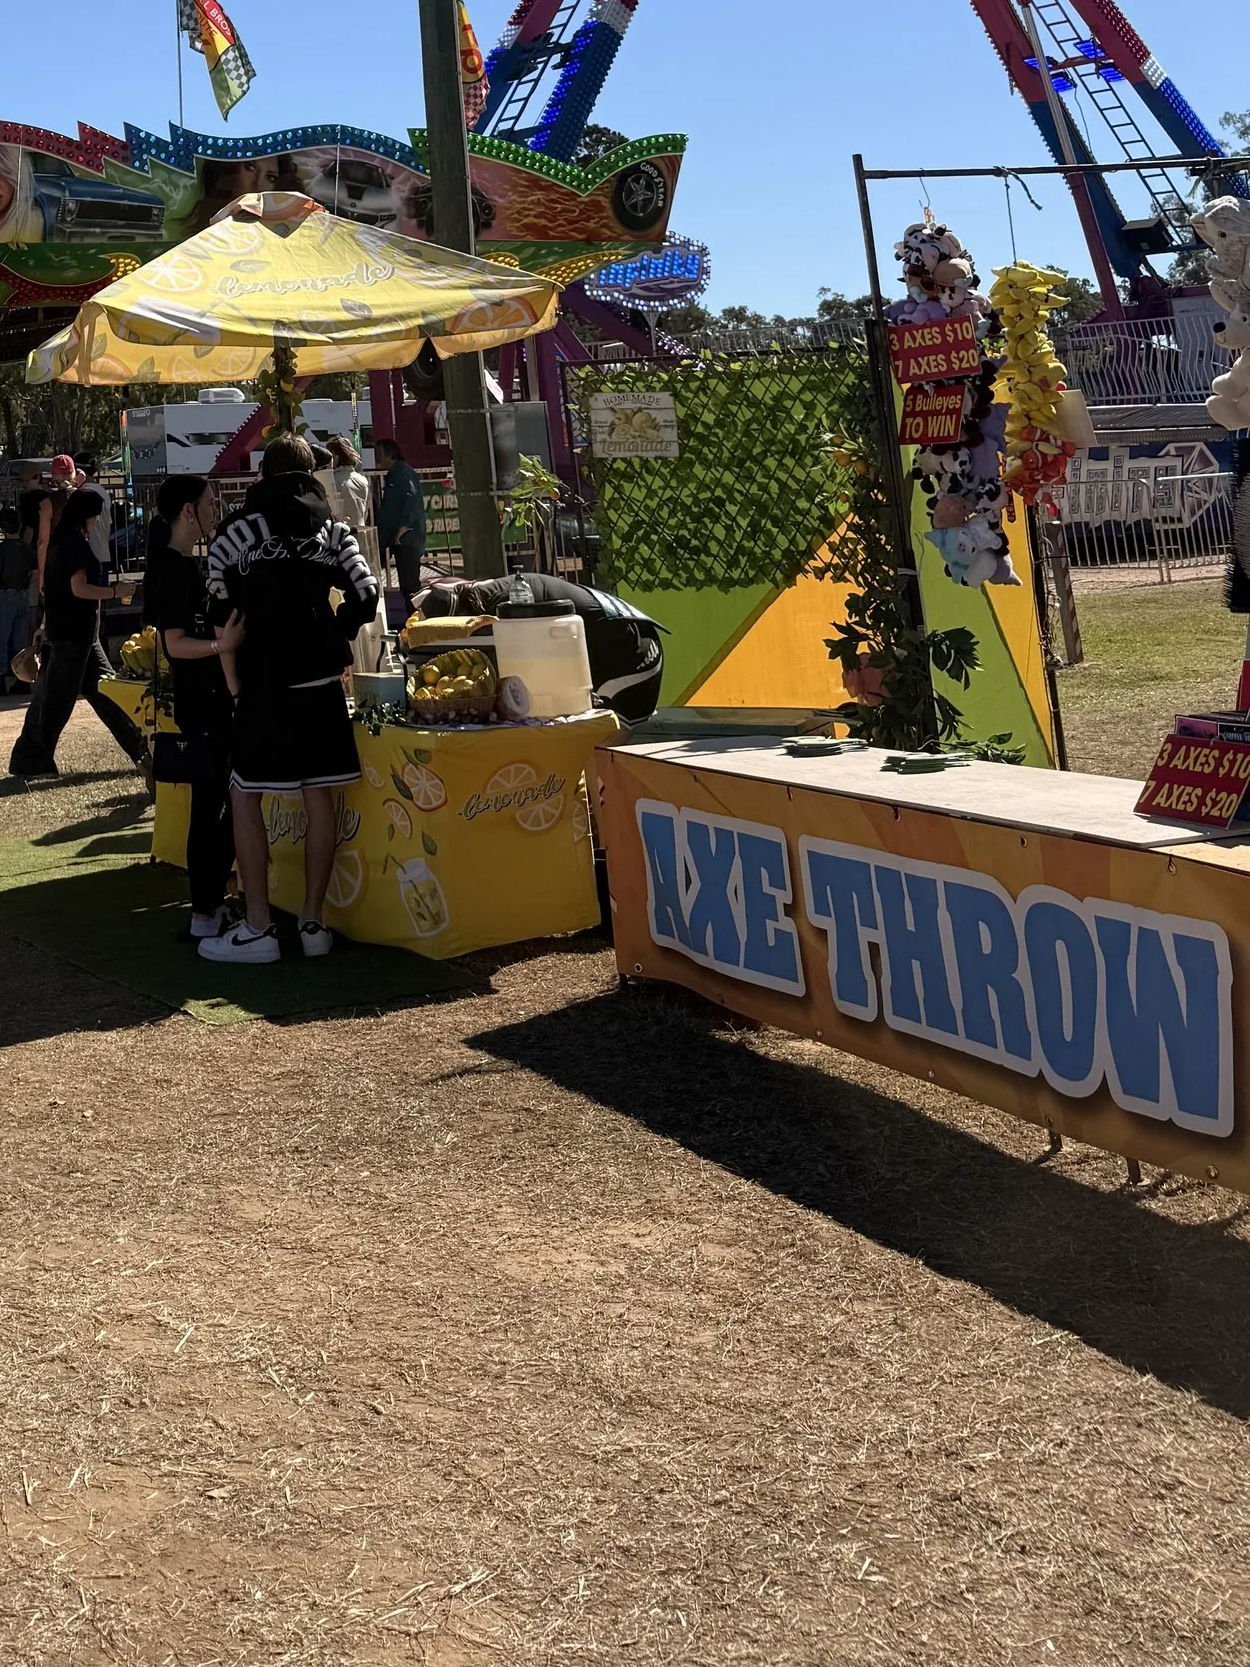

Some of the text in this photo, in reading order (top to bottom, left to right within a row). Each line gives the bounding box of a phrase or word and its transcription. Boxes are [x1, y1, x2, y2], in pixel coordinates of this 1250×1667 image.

[214, 261, 397, 298] lemonade
[890, 322, 973, 351] 3 AXES $10
[895, 349, 979, 378] 7 AXES $20
[603, 394, 662, 406] HOMEMADE
[905, 393, 962, 413] 5 Bulleyes
[905, 414, 957, 439] TO WIN
[1156, 743, 1172, 767] 3
[1168, 745, 1220, 774] AXES
[457, 774, 565, 821] lemonade
[1138, 780, 1239, 818] 7 AXES $20
[638, 804, 1227, 1129] AXE THROW
